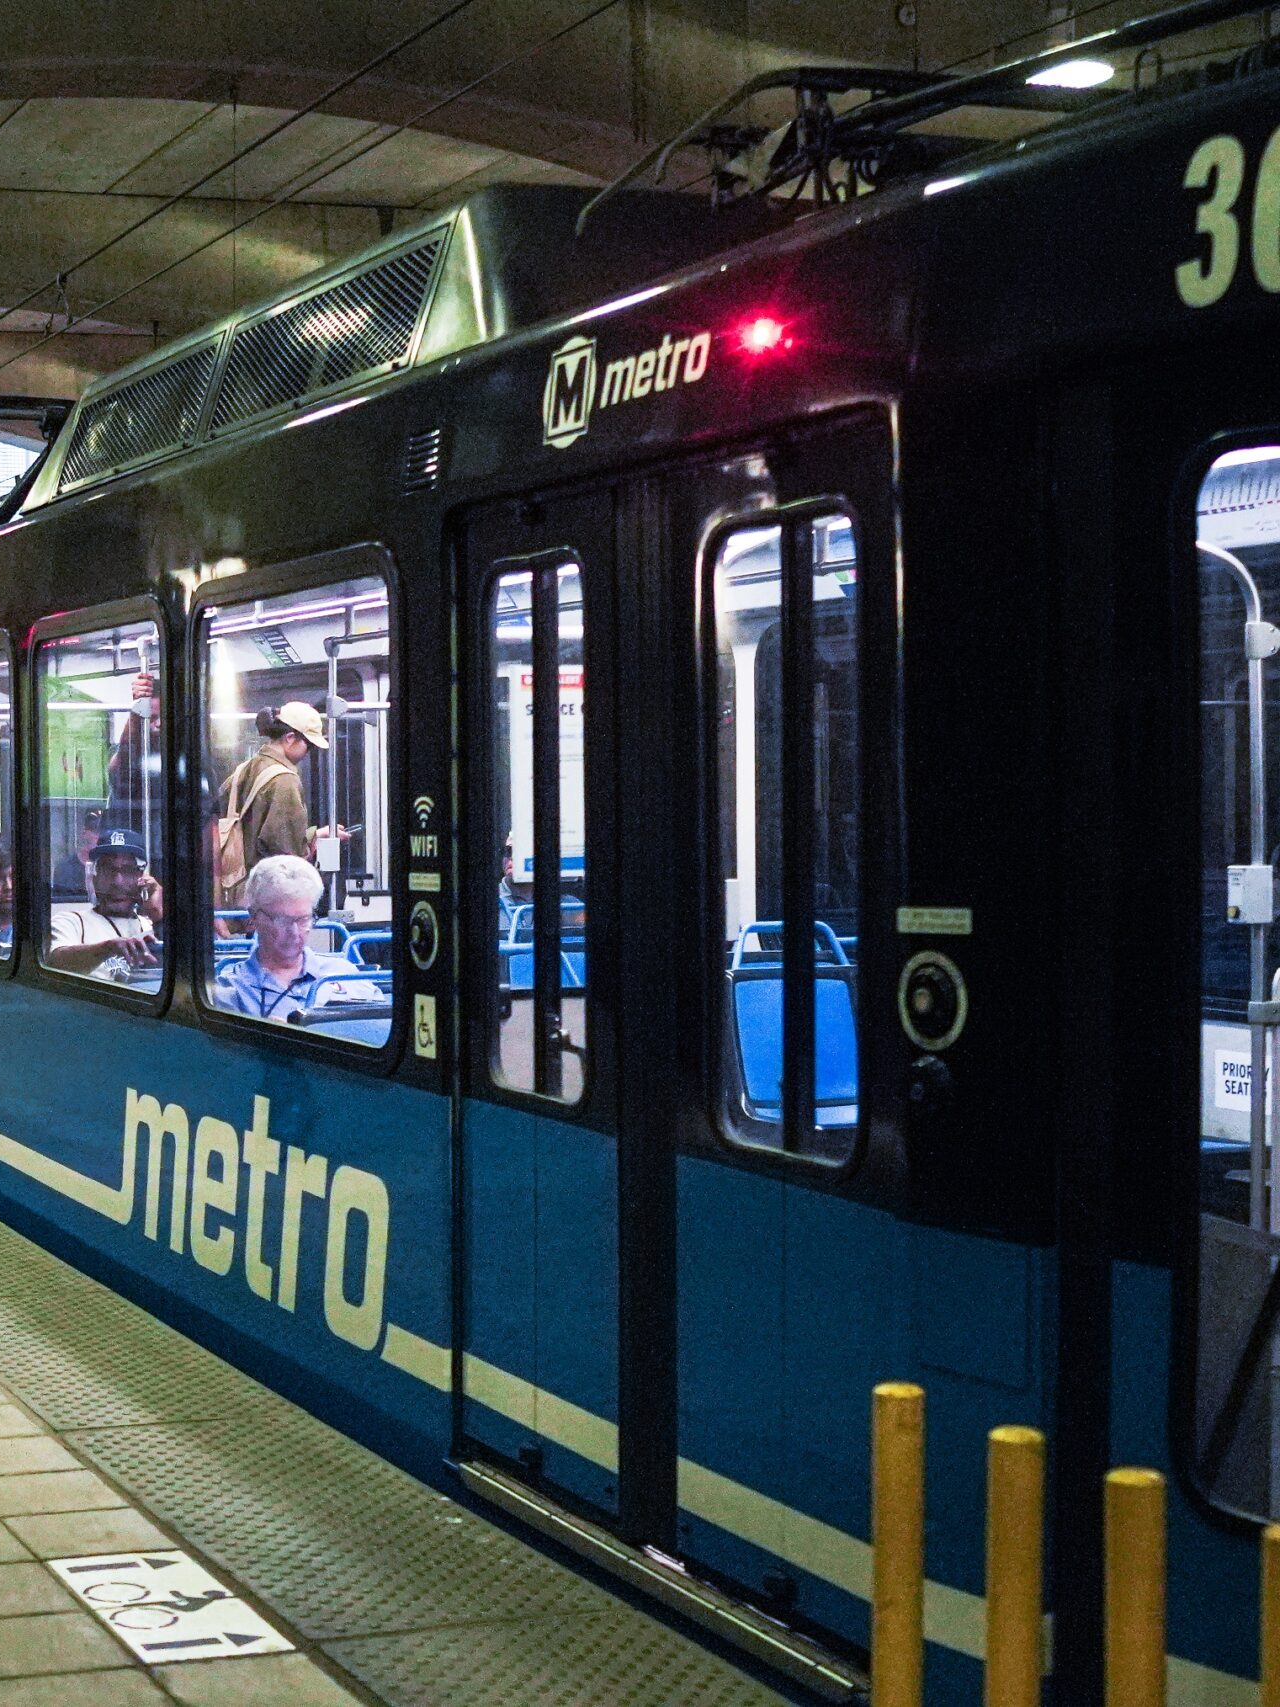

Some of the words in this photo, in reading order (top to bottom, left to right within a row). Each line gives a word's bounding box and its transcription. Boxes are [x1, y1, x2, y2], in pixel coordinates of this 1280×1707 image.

[600, 332, 711, 409] metro
[410, 835, 438, 856] WIFI
[120, 1087, 390, 1351] metro
